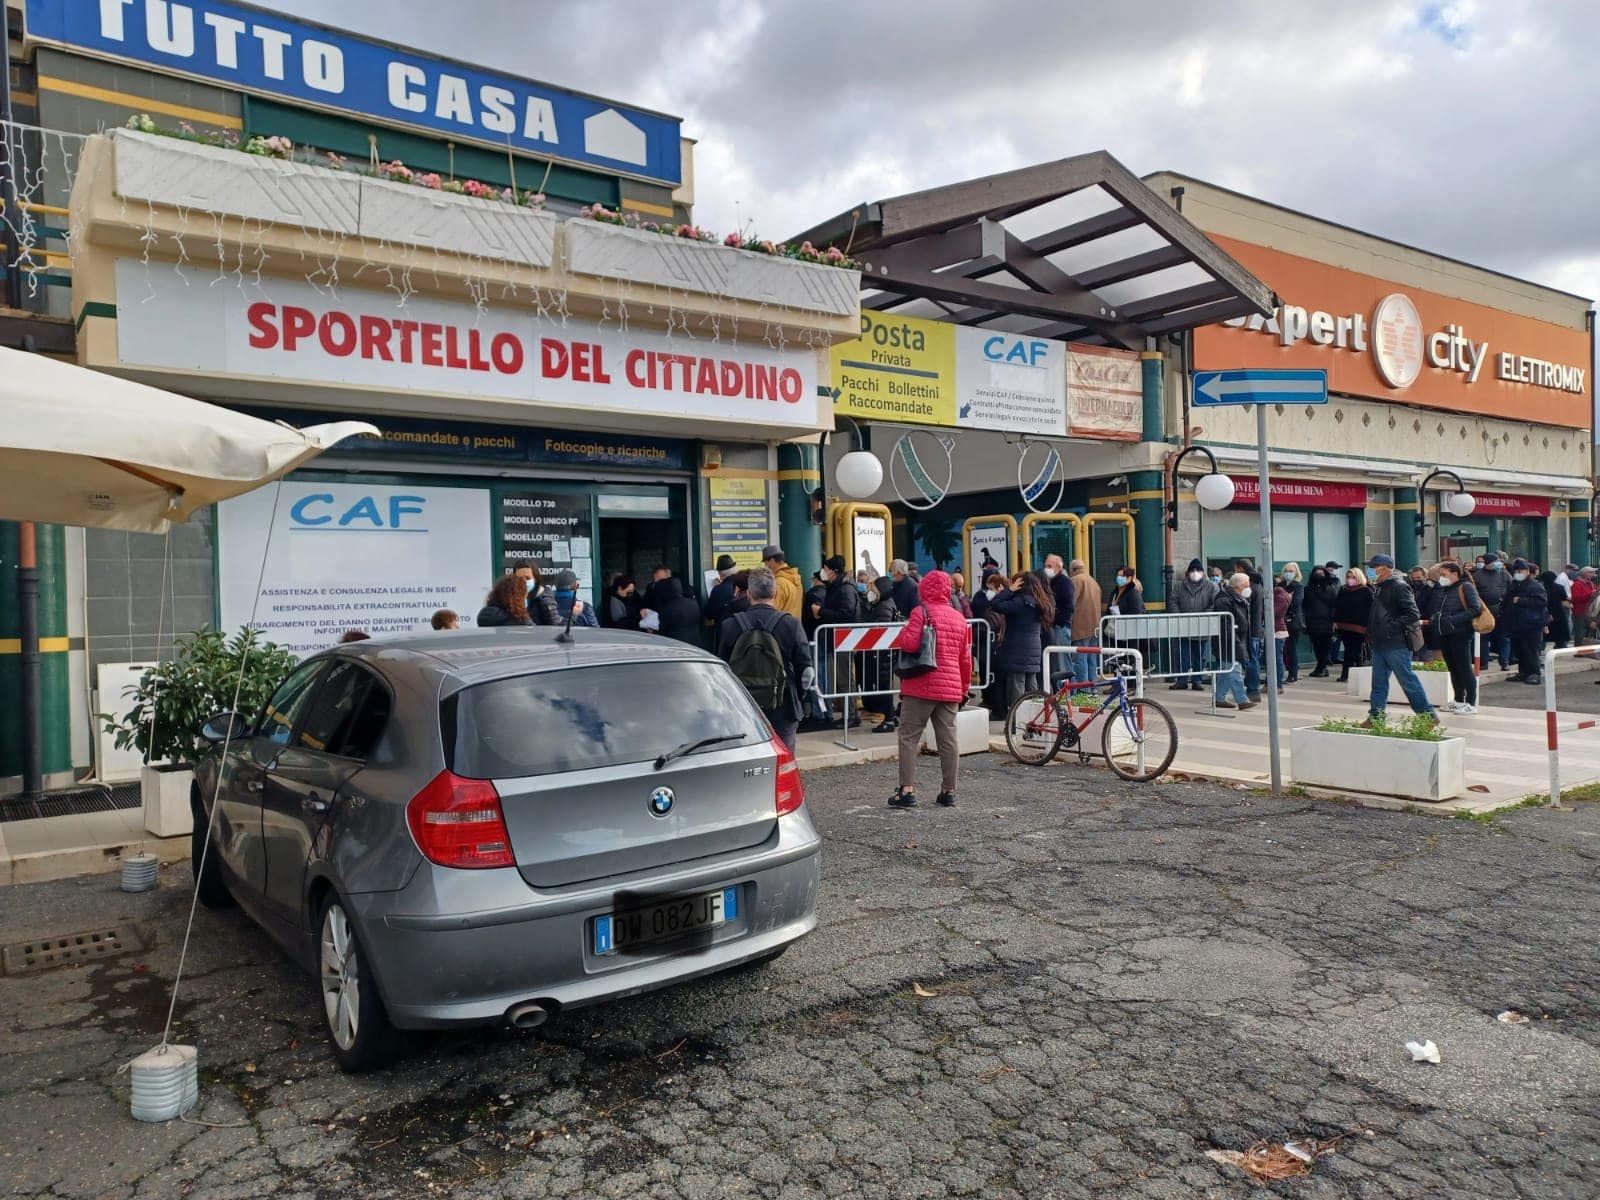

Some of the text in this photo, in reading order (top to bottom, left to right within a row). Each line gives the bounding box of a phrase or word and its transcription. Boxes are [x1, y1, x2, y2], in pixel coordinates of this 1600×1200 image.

[387, 61, 559, 145] CASA
[247, 302, 803, 404] SPORTELLO DEL CITTADINO
[871, 349, 911, 367] Privata
[983, 336, 1049, 366] CAF
[1426, 325, 1488, 383] city
[1497, 351, 1586, 394] ELETTROMIX
[841, 375, 939, 399] Pacchi Bollettini
[849, 394, 933, 415] Raccomandate
[462, 435, 470, 446] e
[473, 436, 515, 449] pacchi
[545, 439, 667, 459] Fotocopie e ricariche
[289, 493, 426, 529] CAF
[503, 498, 556, 508] MODELLO 730
[504, 516, 579, 526] MODELLO UNICO PF
[504, 533, 560, 541] MODELLO RED
[505, 550, 542, 559] MODELLO
[261, 587, 321, 596] ASSISTENZA
[329, 587, 389, 595] CONSULENZA
[390, 586, 423, 594] LEGALE
[272, 601, 448, 612] RESPONSABILITÀ EXTRACONTRATTUALE
[319, 619, 337, 627] DEL
[339, 618, 371, 626] DANNO
[372, 617, 419, 625] DERIVANTE
[371, 625, 413, 633] MALATTIE
